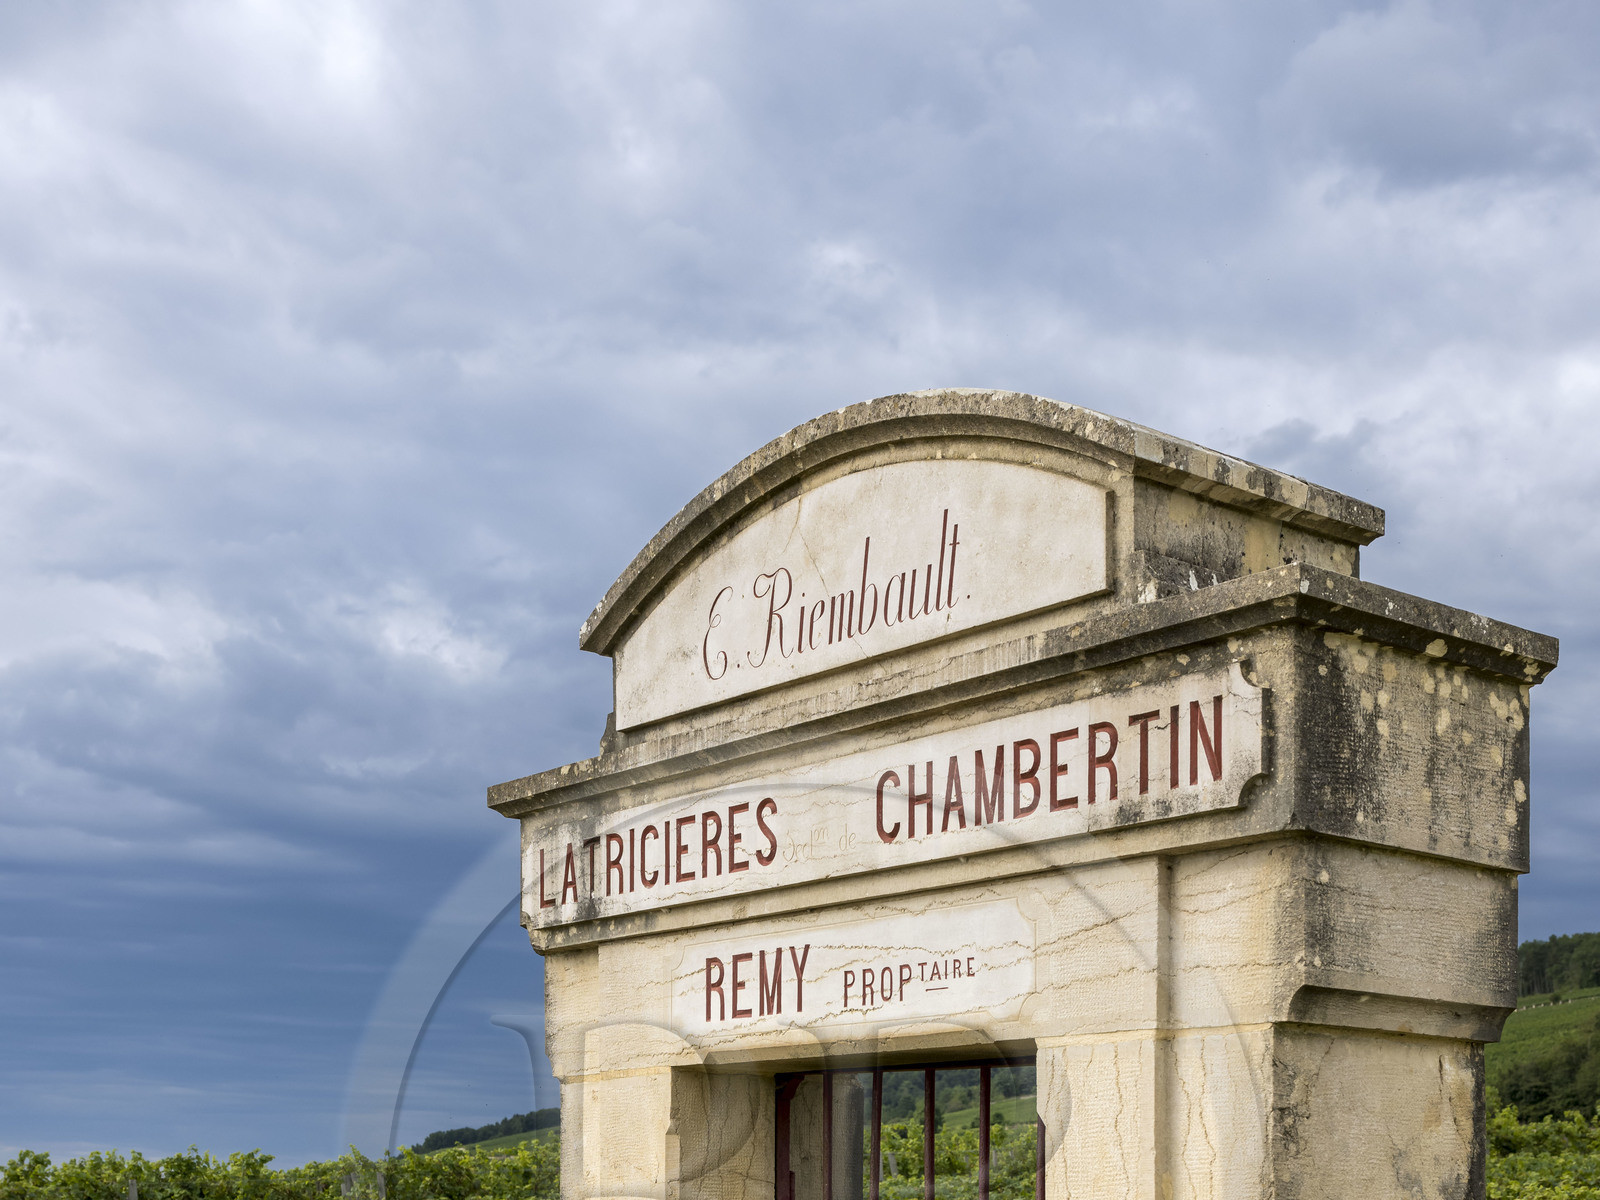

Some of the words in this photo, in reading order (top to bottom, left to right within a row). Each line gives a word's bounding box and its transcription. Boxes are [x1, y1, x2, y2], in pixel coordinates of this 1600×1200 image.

[539, 798, 778, 909] LATRICIERES
[838, 823, 857, 851] de
[876, 694, 1223, 844] CHAMBERTIN
[705, 943, 811, 1023] REMY
